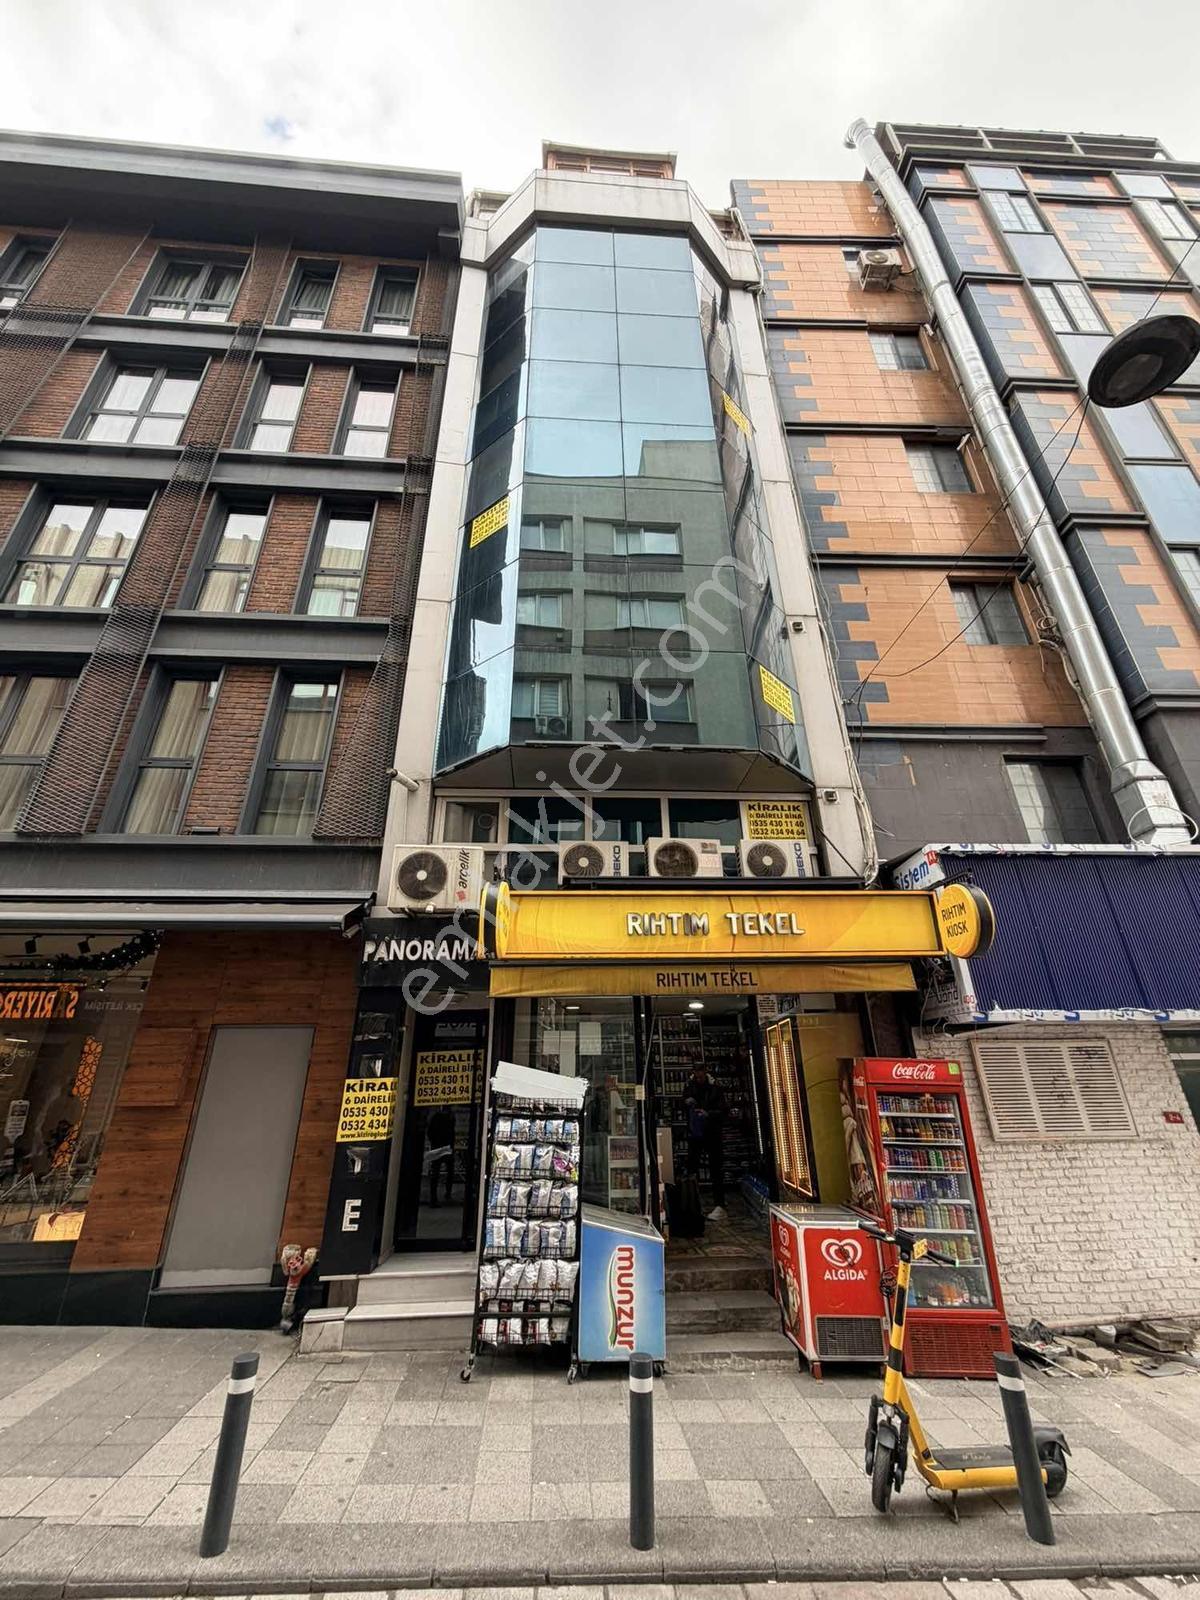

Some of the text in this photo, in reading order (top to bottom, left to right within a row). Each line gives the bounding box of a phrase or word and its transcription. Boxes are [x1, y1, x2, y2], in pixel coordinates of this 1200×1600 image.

[748, 802, 801, 812] KİRALIK
[769, 820, 783, 828] 430
[784, 820, 794, 828] 11
[795, 820, 805, 828] 40
[770, 828, 784, 836] 434
[785, 828, 795, 836] 94
[458, 847, 471, 889] arçelik
[941, 902, 967, 922] RIHTIM
[626, 912, 806, 936] RIHTIM TEKEL
[656, 971, 759, 988] RIHTIM TEKEL
[418, 1075, 440, 1086] 0535
[441, 1074, 458, 1085] 430
[459, 1073, 470, 1084] 11
[417, 1086, 439, 1097] 0532
[441, 1085, 457, 1096] 434
[459, 1084, 470, 1095] 94
[345, 1093, 391, 1105] 6 DAİRELİ
[342, 1105, 388, 1118] 0535 430
[341, 1118, 387, 1131] 0532 434
[616, 1246, 635, 1352] munzur
